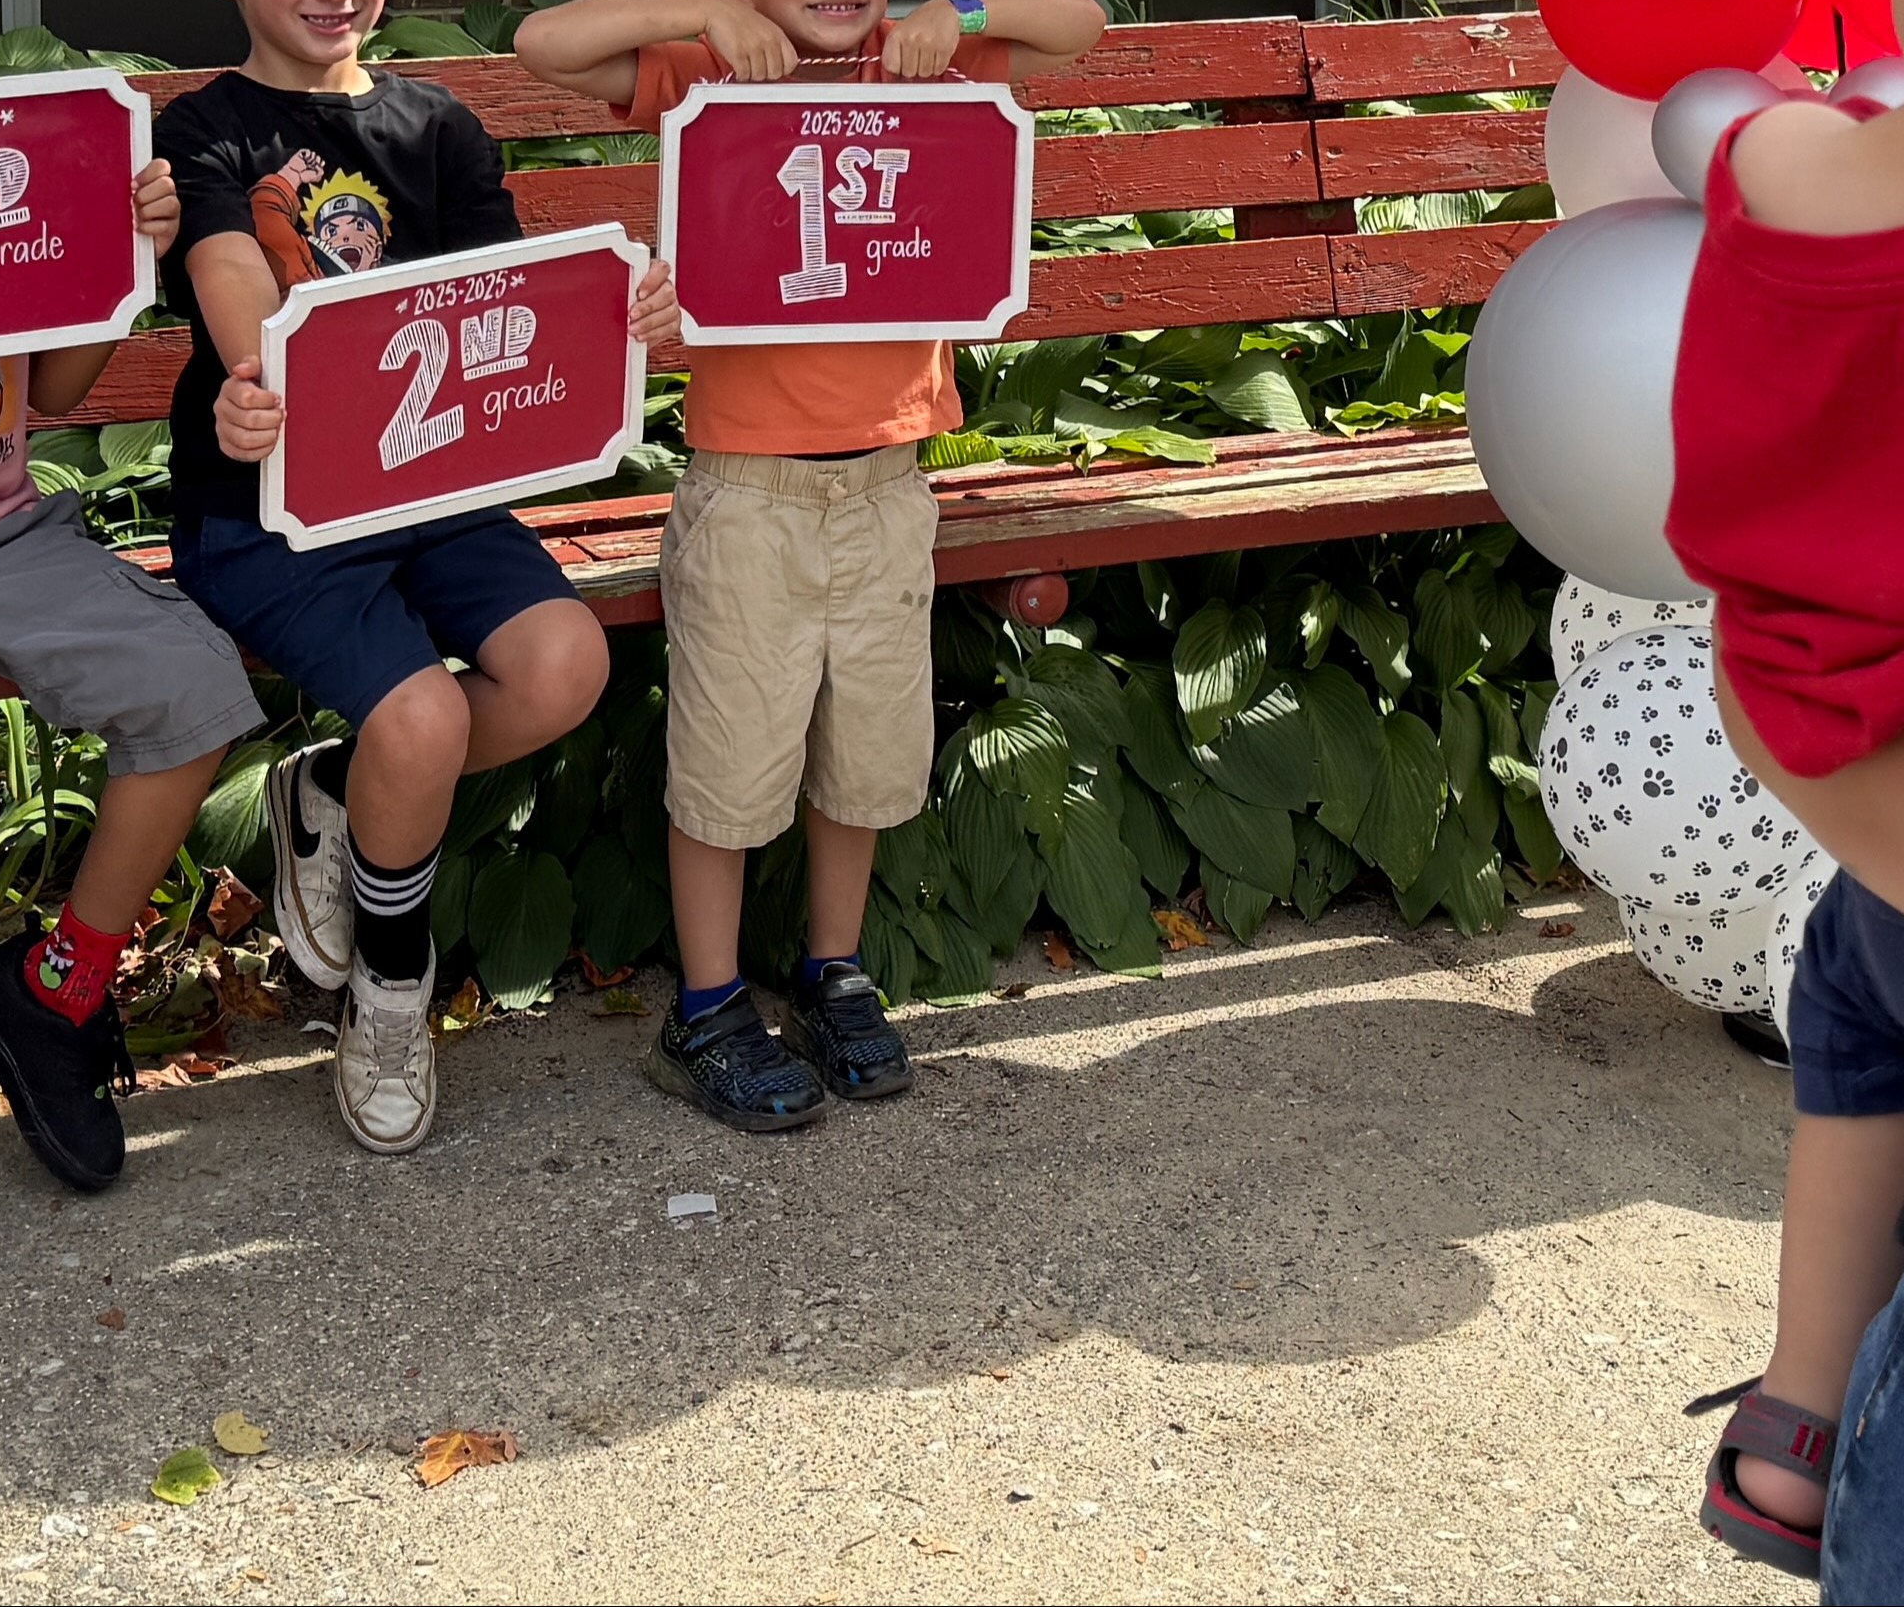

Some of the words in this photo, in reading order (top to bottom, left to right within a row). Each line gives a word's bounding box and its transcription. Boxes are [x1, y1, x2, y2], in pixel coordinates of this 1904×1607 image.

[801, 110, 884, 136] 2025-2026
[866, 226, 932, 276] grade
[482, 363, 567, 431] grade
